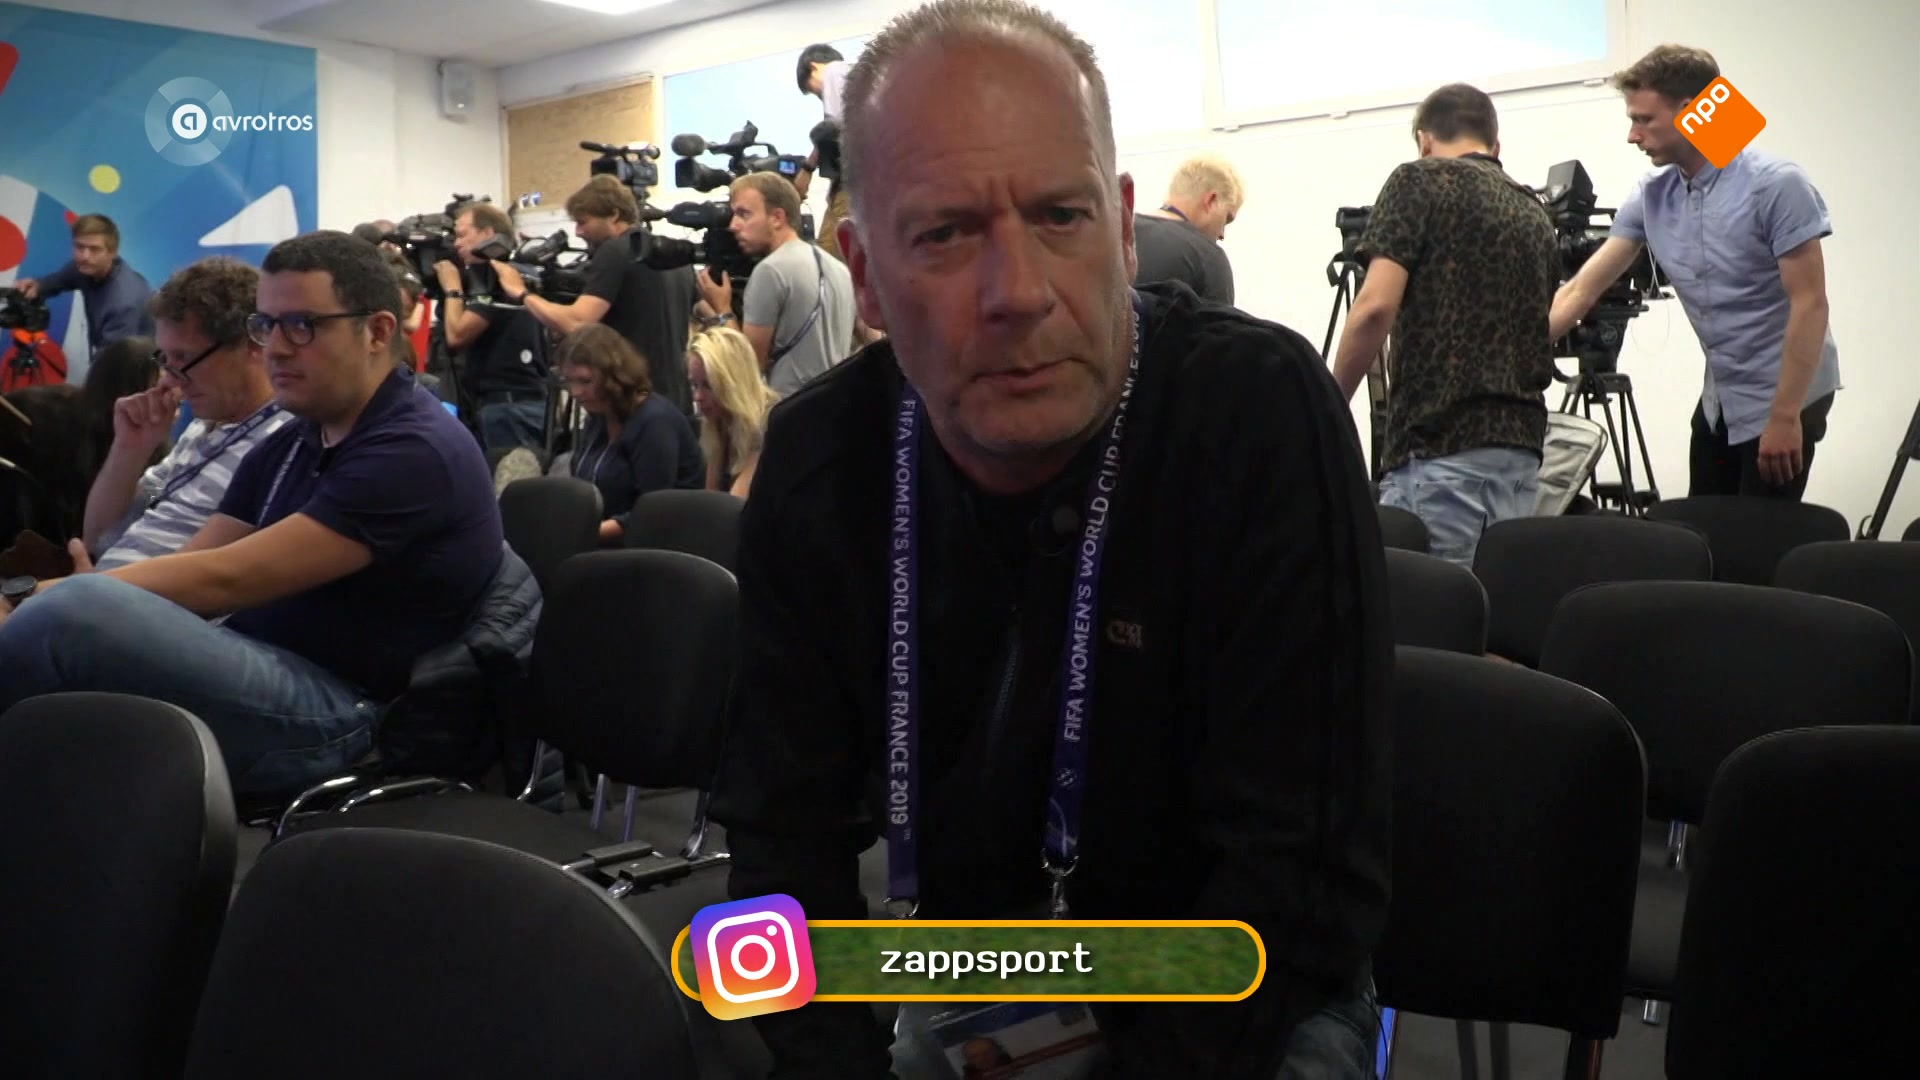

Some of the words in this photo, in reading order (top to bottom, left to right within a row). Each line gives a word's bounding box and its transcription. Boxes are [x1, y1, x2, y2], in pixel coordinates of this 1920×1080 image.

[897, 399, 916, 440] FIFA
[1111, 357, 1140, 439] FRANE
[893, 446, 911, 551] WOMEN'S
[1098, 445, 1121, 493] CUP
[1080, 497, 1110, 577] WORLD
[892, 557, 910, 635] WORLD
[891, 641, 910, 685] CUP
[1068, 583, 1092, 691] WOMEN'S
[889, 691, 909, 774] FRANCE
[1063, 698, 1085, 742] FIFA
[890, 779, 909, 825] 2019
